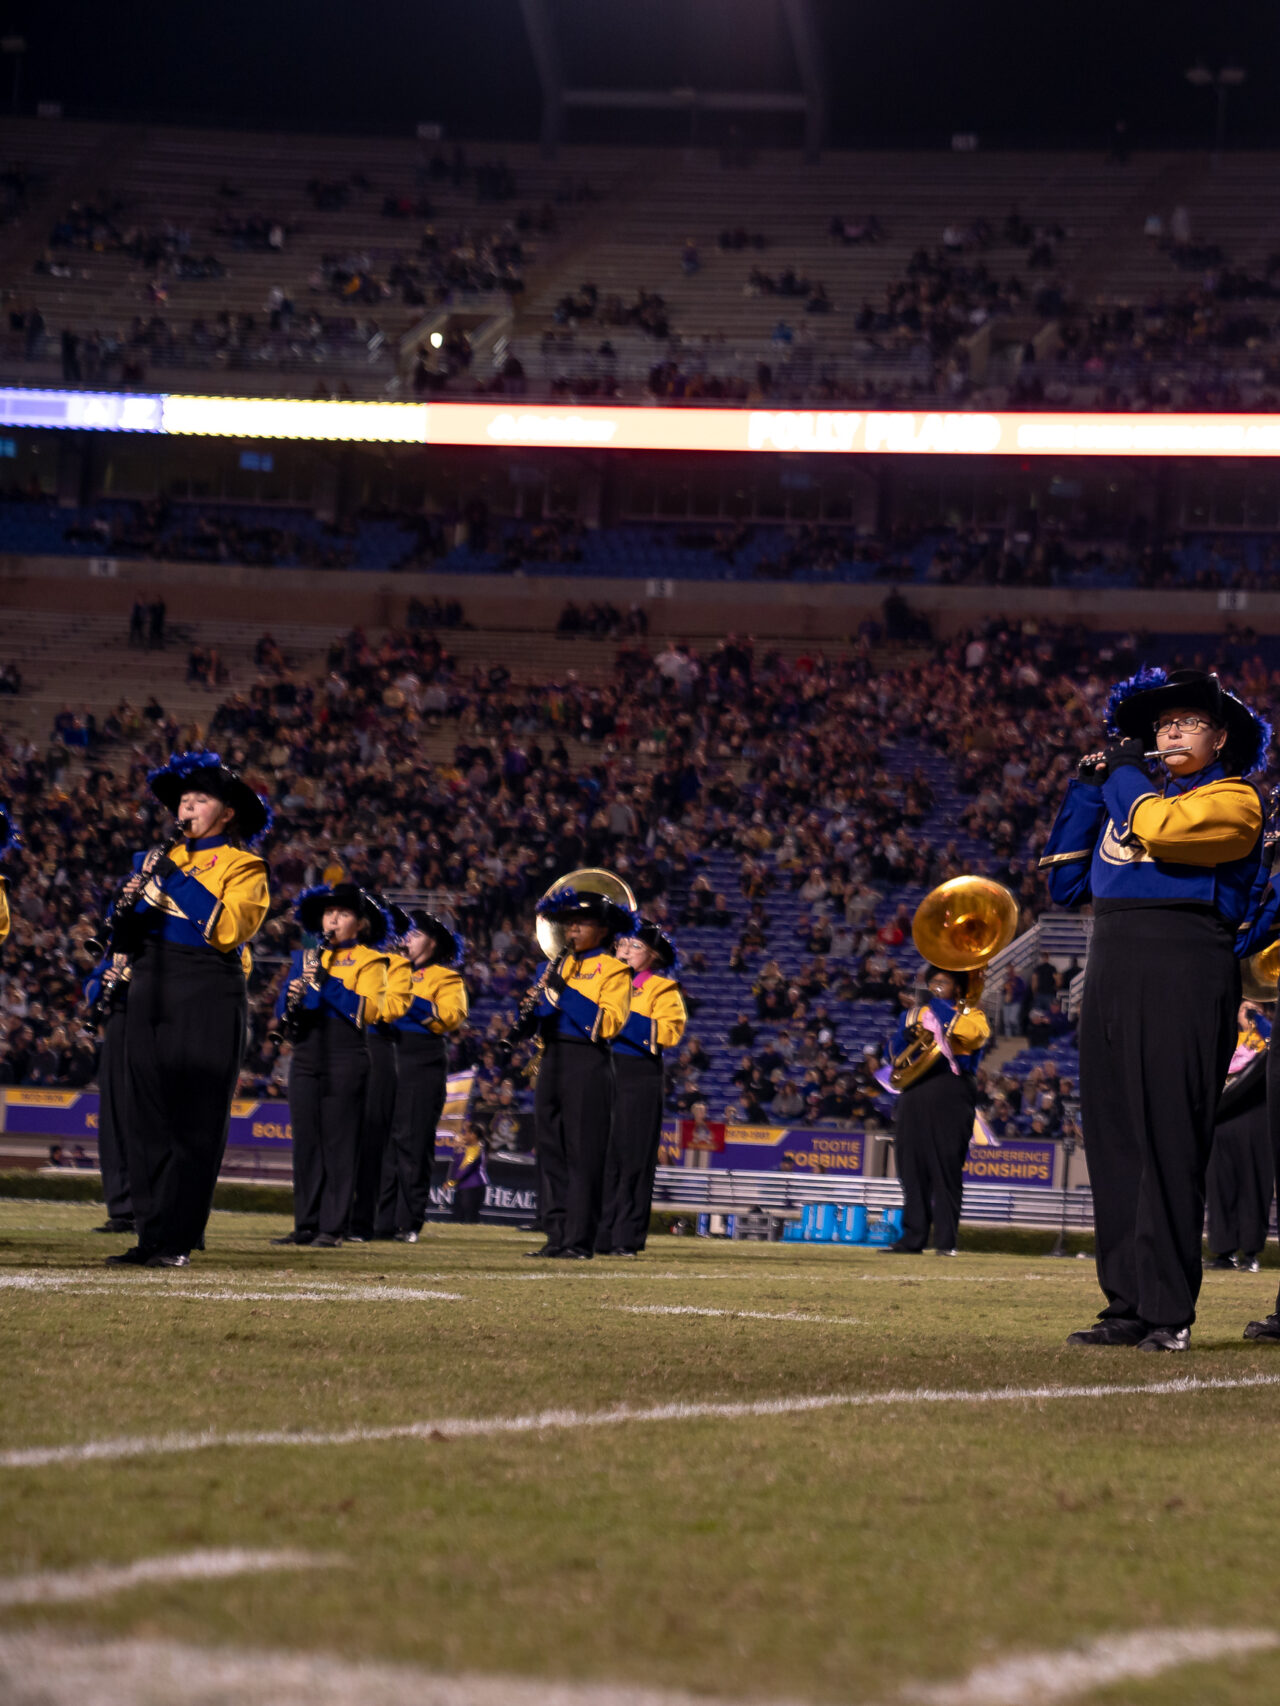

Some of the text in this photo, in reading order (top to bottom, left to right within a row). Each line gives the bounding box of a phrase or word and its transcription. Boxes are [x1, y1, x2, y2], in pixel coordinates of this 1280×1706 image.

[748, 411, 862, 450] POLLY
[811, 1138, 860, 1154] TOOTIE
[970, 1149, 1050, 1163] CONFERENCE
